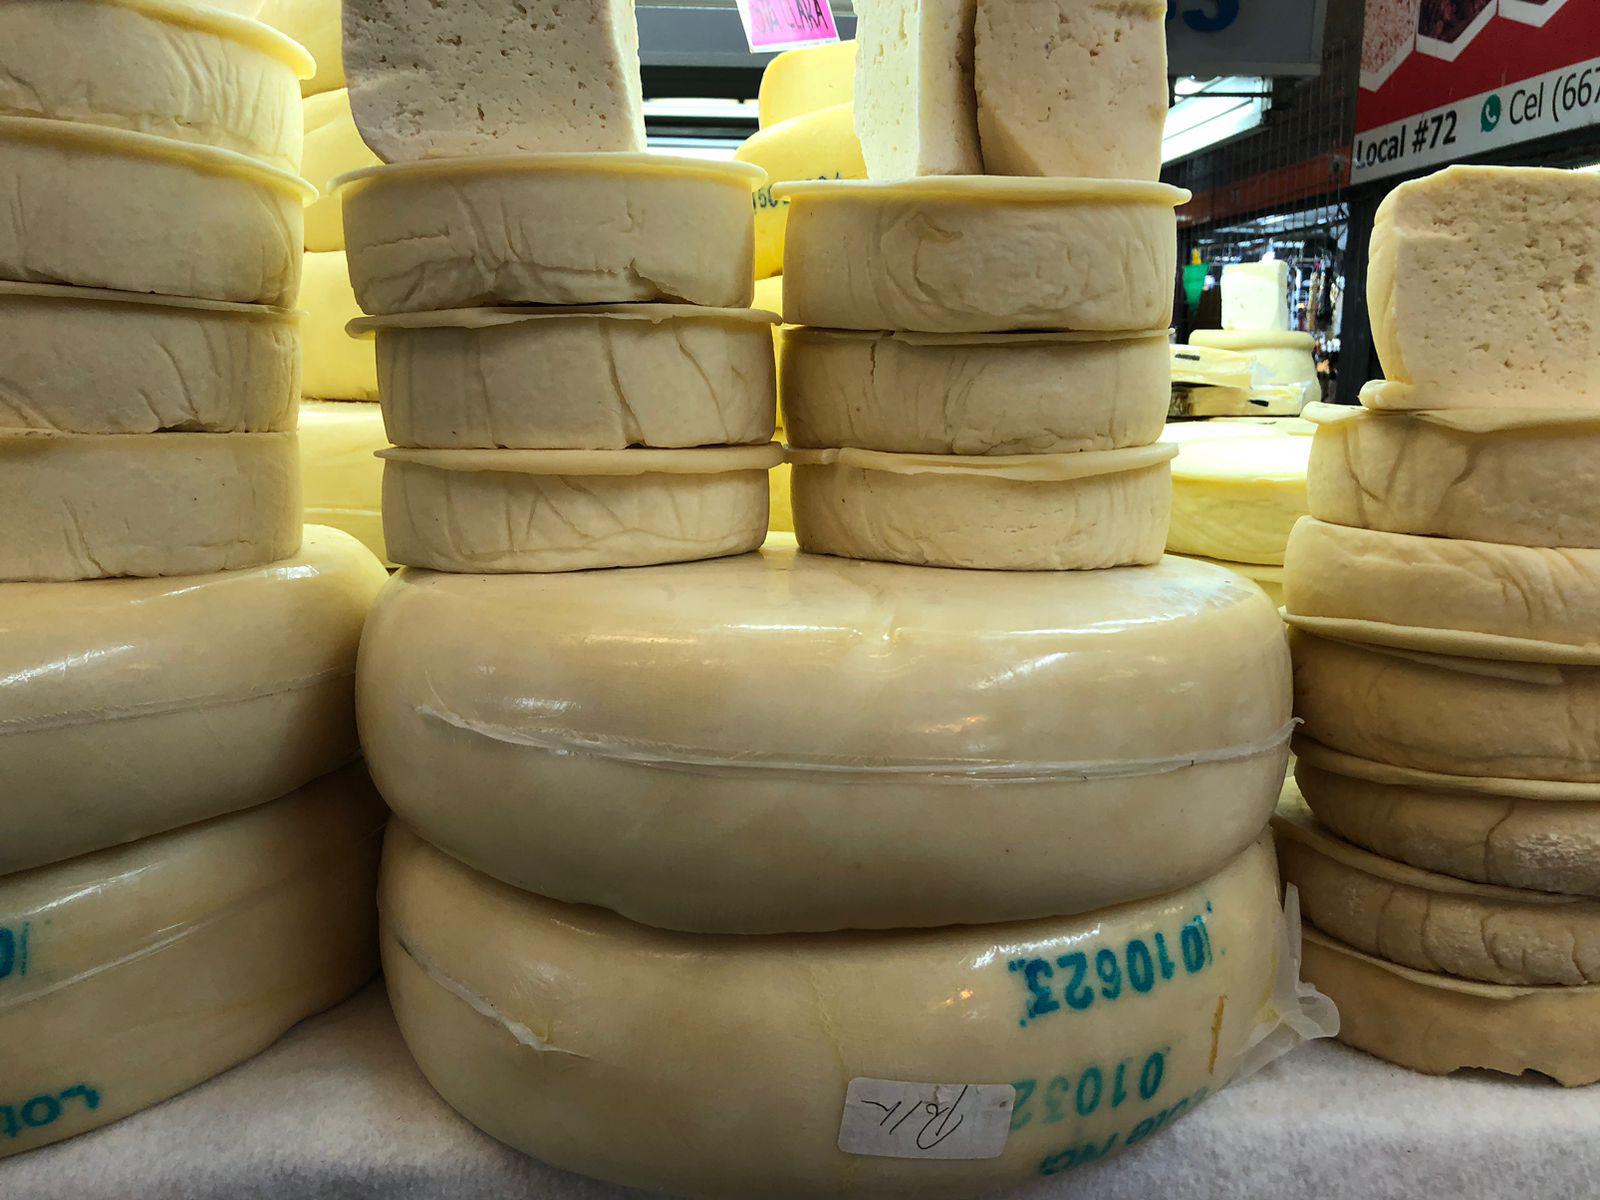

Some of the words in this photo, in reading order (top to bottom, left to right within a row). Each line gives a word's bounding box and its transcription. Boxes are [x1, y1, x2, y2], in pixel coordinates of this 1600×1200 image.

[1356, 124, 1406, 170] Local
[1412, 110, 1458, 154] #72
[1509, 82, 1544, 125] Cel
